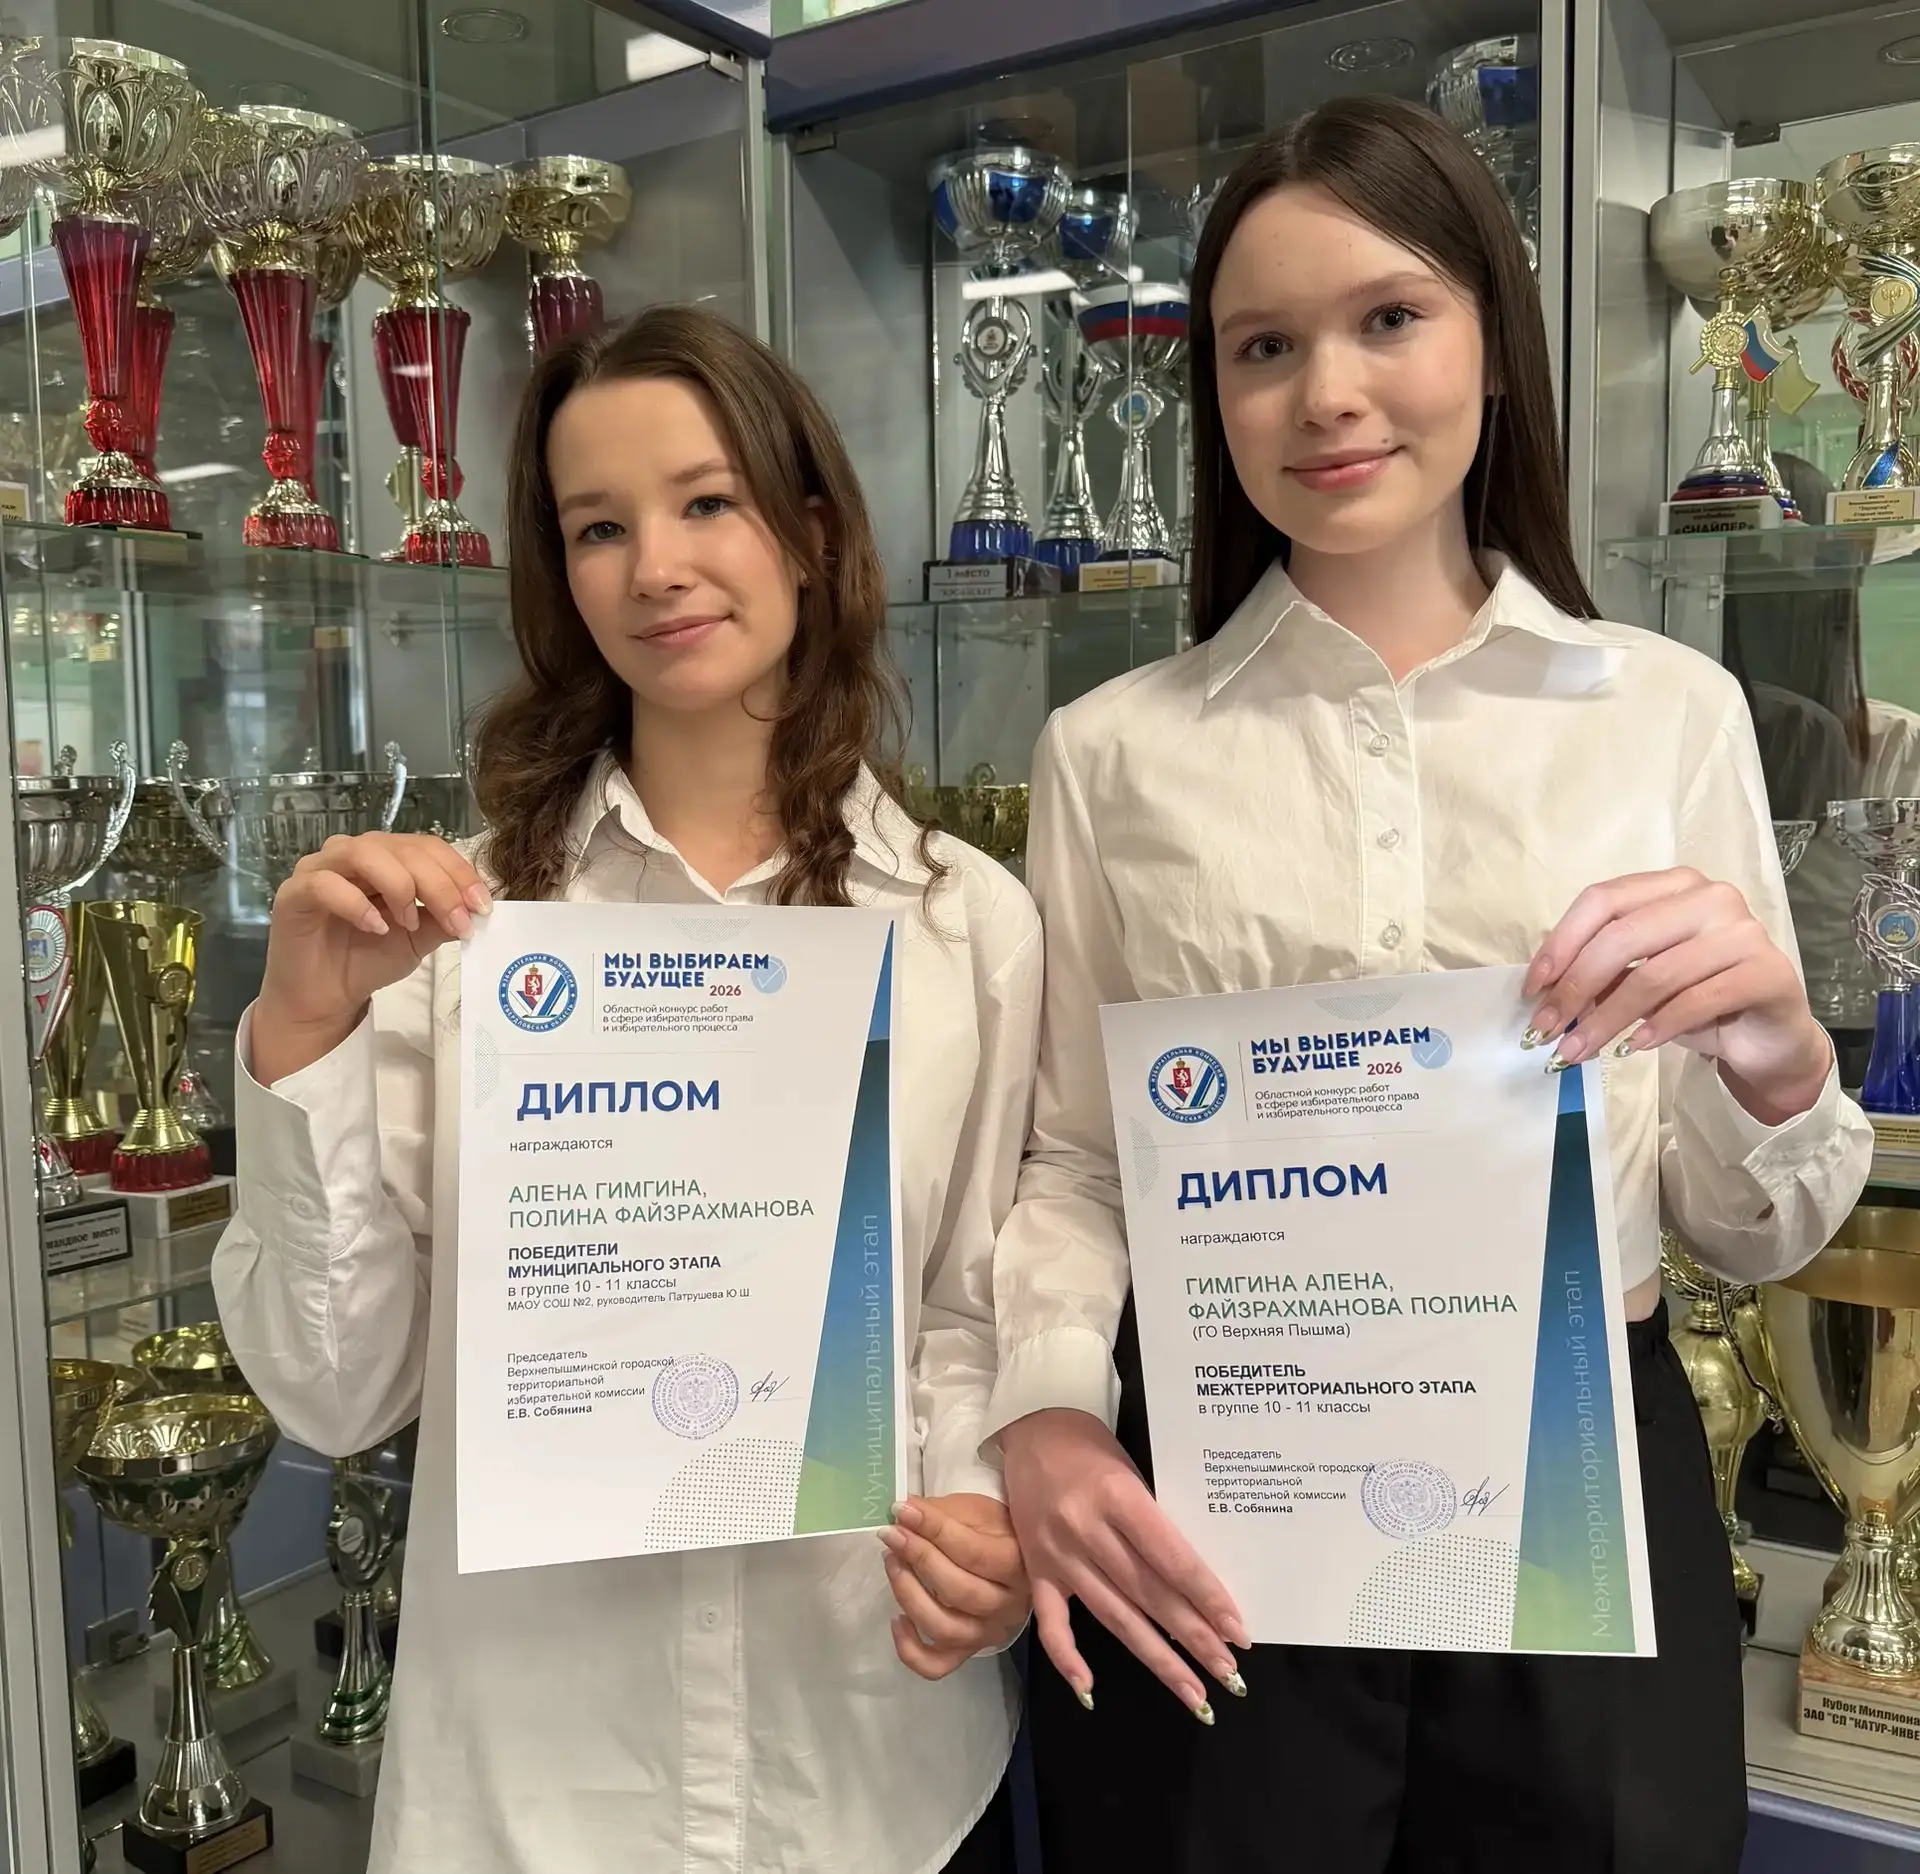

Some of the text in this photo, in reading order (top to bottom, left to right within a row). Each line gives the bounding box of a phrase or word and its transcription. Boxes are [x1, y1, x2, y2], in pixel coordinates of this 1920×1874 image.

[954, 568, 990, 579] место
[604, 953, 769, 970] МЫ ВЫБИРАЕМ
[604, 971, 742, 997] БУДУЩЕЕ 2026
[603, 1004, 728, 1015] Областной конкурс работ
[603, 1013, 754, 1024] в сфере избирательного права
[611, 1023, 690, 1033] избирательного
[693, 1023, 738, 1033] процесса
[1250, 1026, 1431, 1056] МЫ ВЫБИРАЕМ
[1253, 1051, 1403, 1076] БУДУЩЕЕ 2026
[1255, 1083, 1390, 1100] Областной конкурс работ
[517, 1080, 720, 1121] ДИПЛОМ
[1264, 1099, 1299, 1112] сфере
[1301, 1093, 1385, 1107] избирательного
[1388, 1092, 1420, 1102] права
[1266, 1107, 1350, 1120] избирательного
[1352, 1103, 1403, 1116] процесса
[510, 1138, 613, 1153] награждаются
[508, 1179, 707, 1203] АЛЕНА ГИМГИНА,
[1177, 1162, 1388, 1210] ДИПЛОМ
[510, 1198, 815, 1228] ПОЛИНА ФАЙЗРАХМАНОВА
[92, 1226, 120, 1240] место
[1180, 1229, 1285, 1247] награждаются
[508, 1243, 618, 1260] ПОБЕДИТЕЛИ
[508, 1256, 721, 1278] МУНИЦИПАЛЬНОГО ЭТАПА
[508, 1288, 516, 1296] в
[521, 1284, 570, 1298] группе
[575, 1279, 591, 1292] 10
[606, 1279, 621, 1291] 11
[626, 1278, 677, 1291] классы
[1185, 1272, 1394, 1295] ГИМГИНА АЛЕНА,
[507, 1300, 541, 1311] МАОУ
[543, 1298, 570, 1309] СОШ
[597, 1294, 666, 1308] руководитель
[668, 1290, 724, 1304] Патрушева
[1188, 1294, 1518, 1320] ФАЙЗРАХМАНОВА ПОЛИНА
[1192, 1322, 1351, 1341] (ГО Верхняя Пышма)
[507, 1350, 588, 1364] Председатель
[507, 1357, 675, 1379] Верхнепышминской городской
[859, 1214, 888, 1520] Муниципальный этап
[1195, 1364, 1306, 1380] ПОБЕДИТЕЛЬ
[507, 1375, 604, 1392] территориальной
[1196, 1380, 1476, 1396] МЕЖТЕРРИТОРИАЛЬНОГО ЭТАПА
[507, 1387, 645, 1405] избирательной комиссии
[507, 1404, 592, 1419] Е.В. Собянина
[1199, 1404, 1207, 1414] в
[1211, 1404, 1259, 1416] группе
[1264, 1402, 1281, 1413] 10
[1296, 1401, 1311, 1413] 11
[1317, 1402, 1371, 1413] классы
[1203, 1449, 1282, 1460] Председатель
[1565, 1270, 1612, 1638] Межтерриториальный этап
[1205, 1462, 1376, 1474] Верхнепышминской городской
[1206, 1475, 1303, 1487] территориальной
[1207, 1489, 1346, 1501] избирательной комиссии
[1209, 1503, 1293, 1513] Е.В. Собянина
[1822, 1697, 1857, 1713] Кубок
[1803, 1708, 1825, 1721] ЗАО
